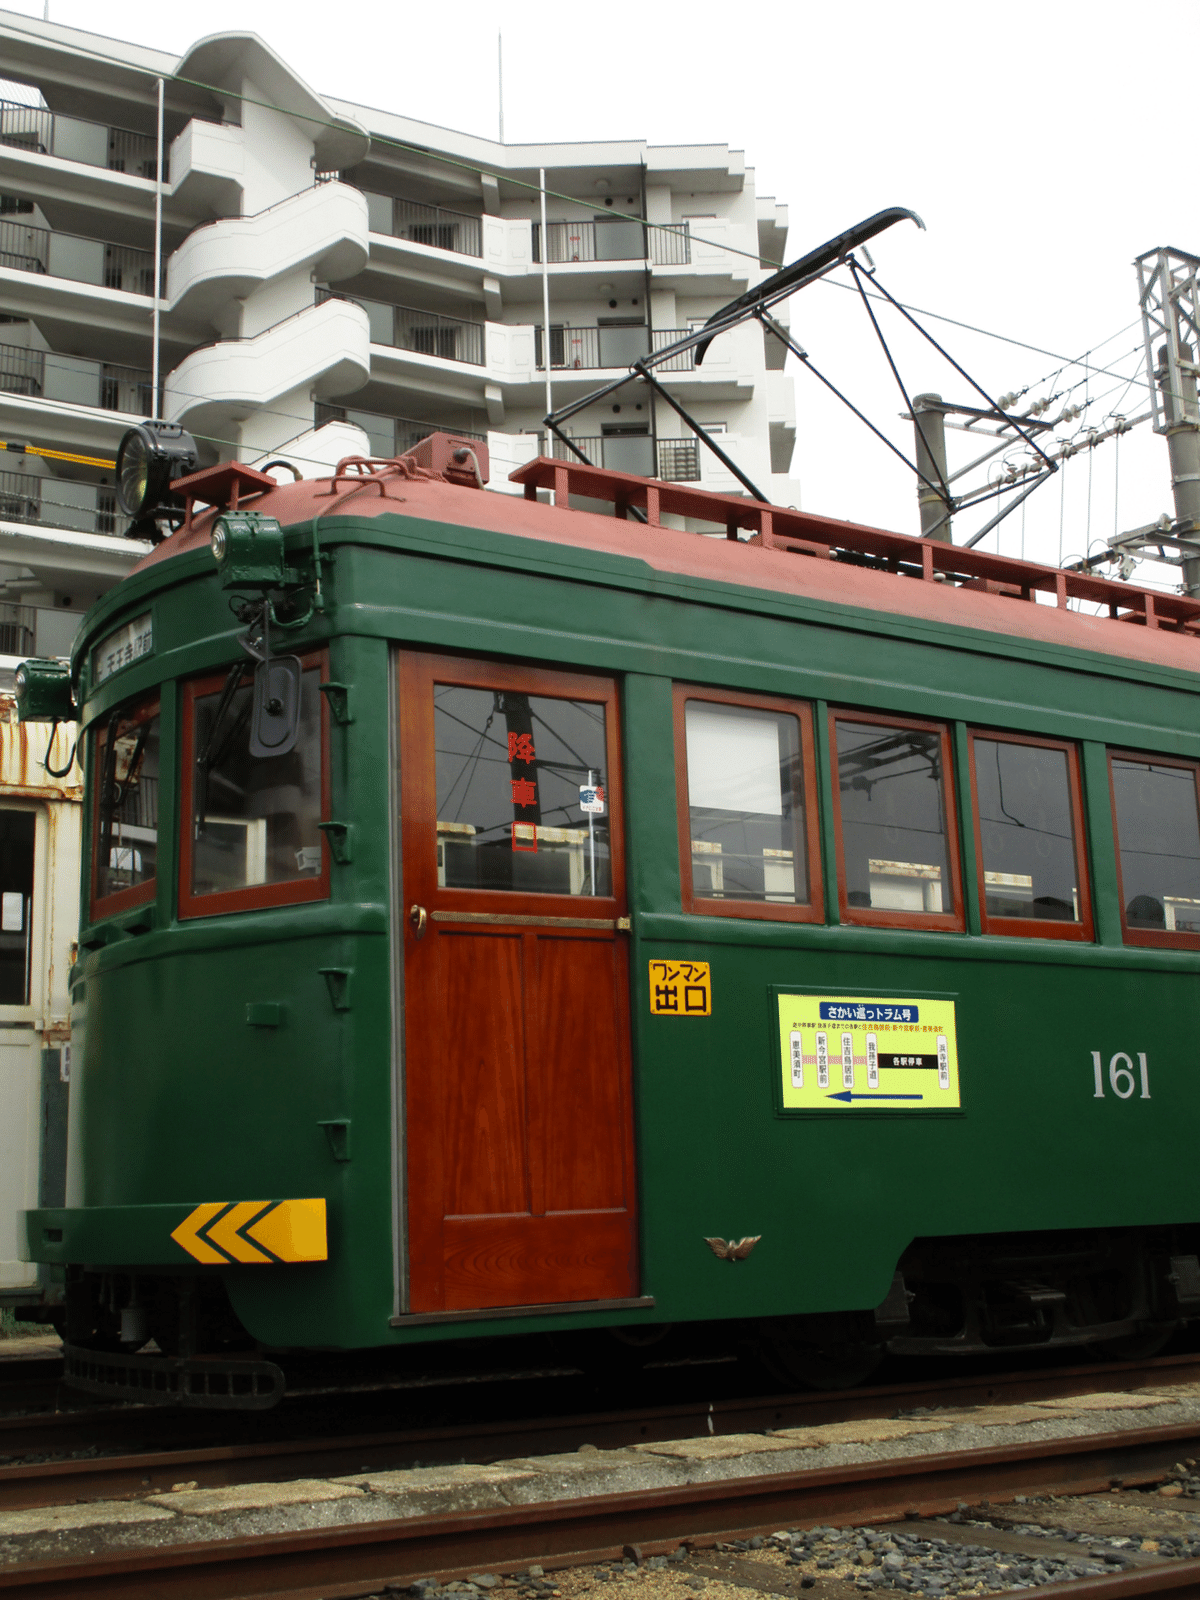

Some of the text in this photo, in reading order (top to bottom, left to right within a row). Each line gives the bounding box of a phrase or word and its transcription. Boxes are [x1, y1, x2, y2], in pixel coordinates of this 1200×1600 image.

[653, 963, 706, 982] ワンマン
[655, 985, 706, 1012] 出口
[817, 1036, 828, 1084] 新今宮駅前
[892, 1057, 923, 1067] 各駅停車
[1090, 1051, 1151, 1099] 161
